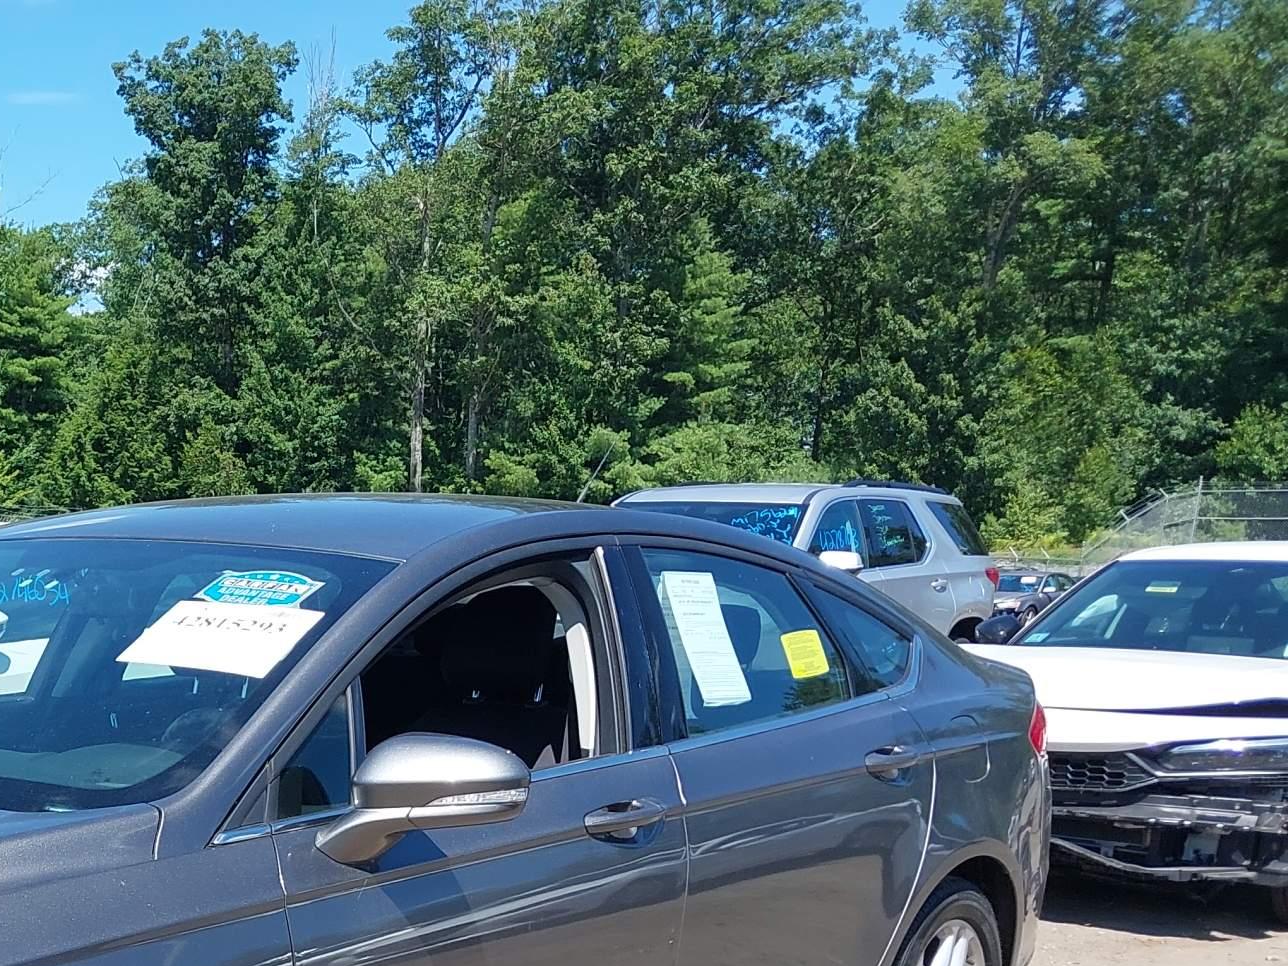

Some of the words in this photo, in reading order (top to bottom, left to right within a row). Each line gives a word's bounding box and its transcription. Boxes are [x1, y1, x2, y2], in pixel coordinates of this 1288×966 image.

[217, 586, 290, 600] ADVANTAGE
[220, 594, 269, 605] DEALER
[173, 615, 287, 634] 42815293
